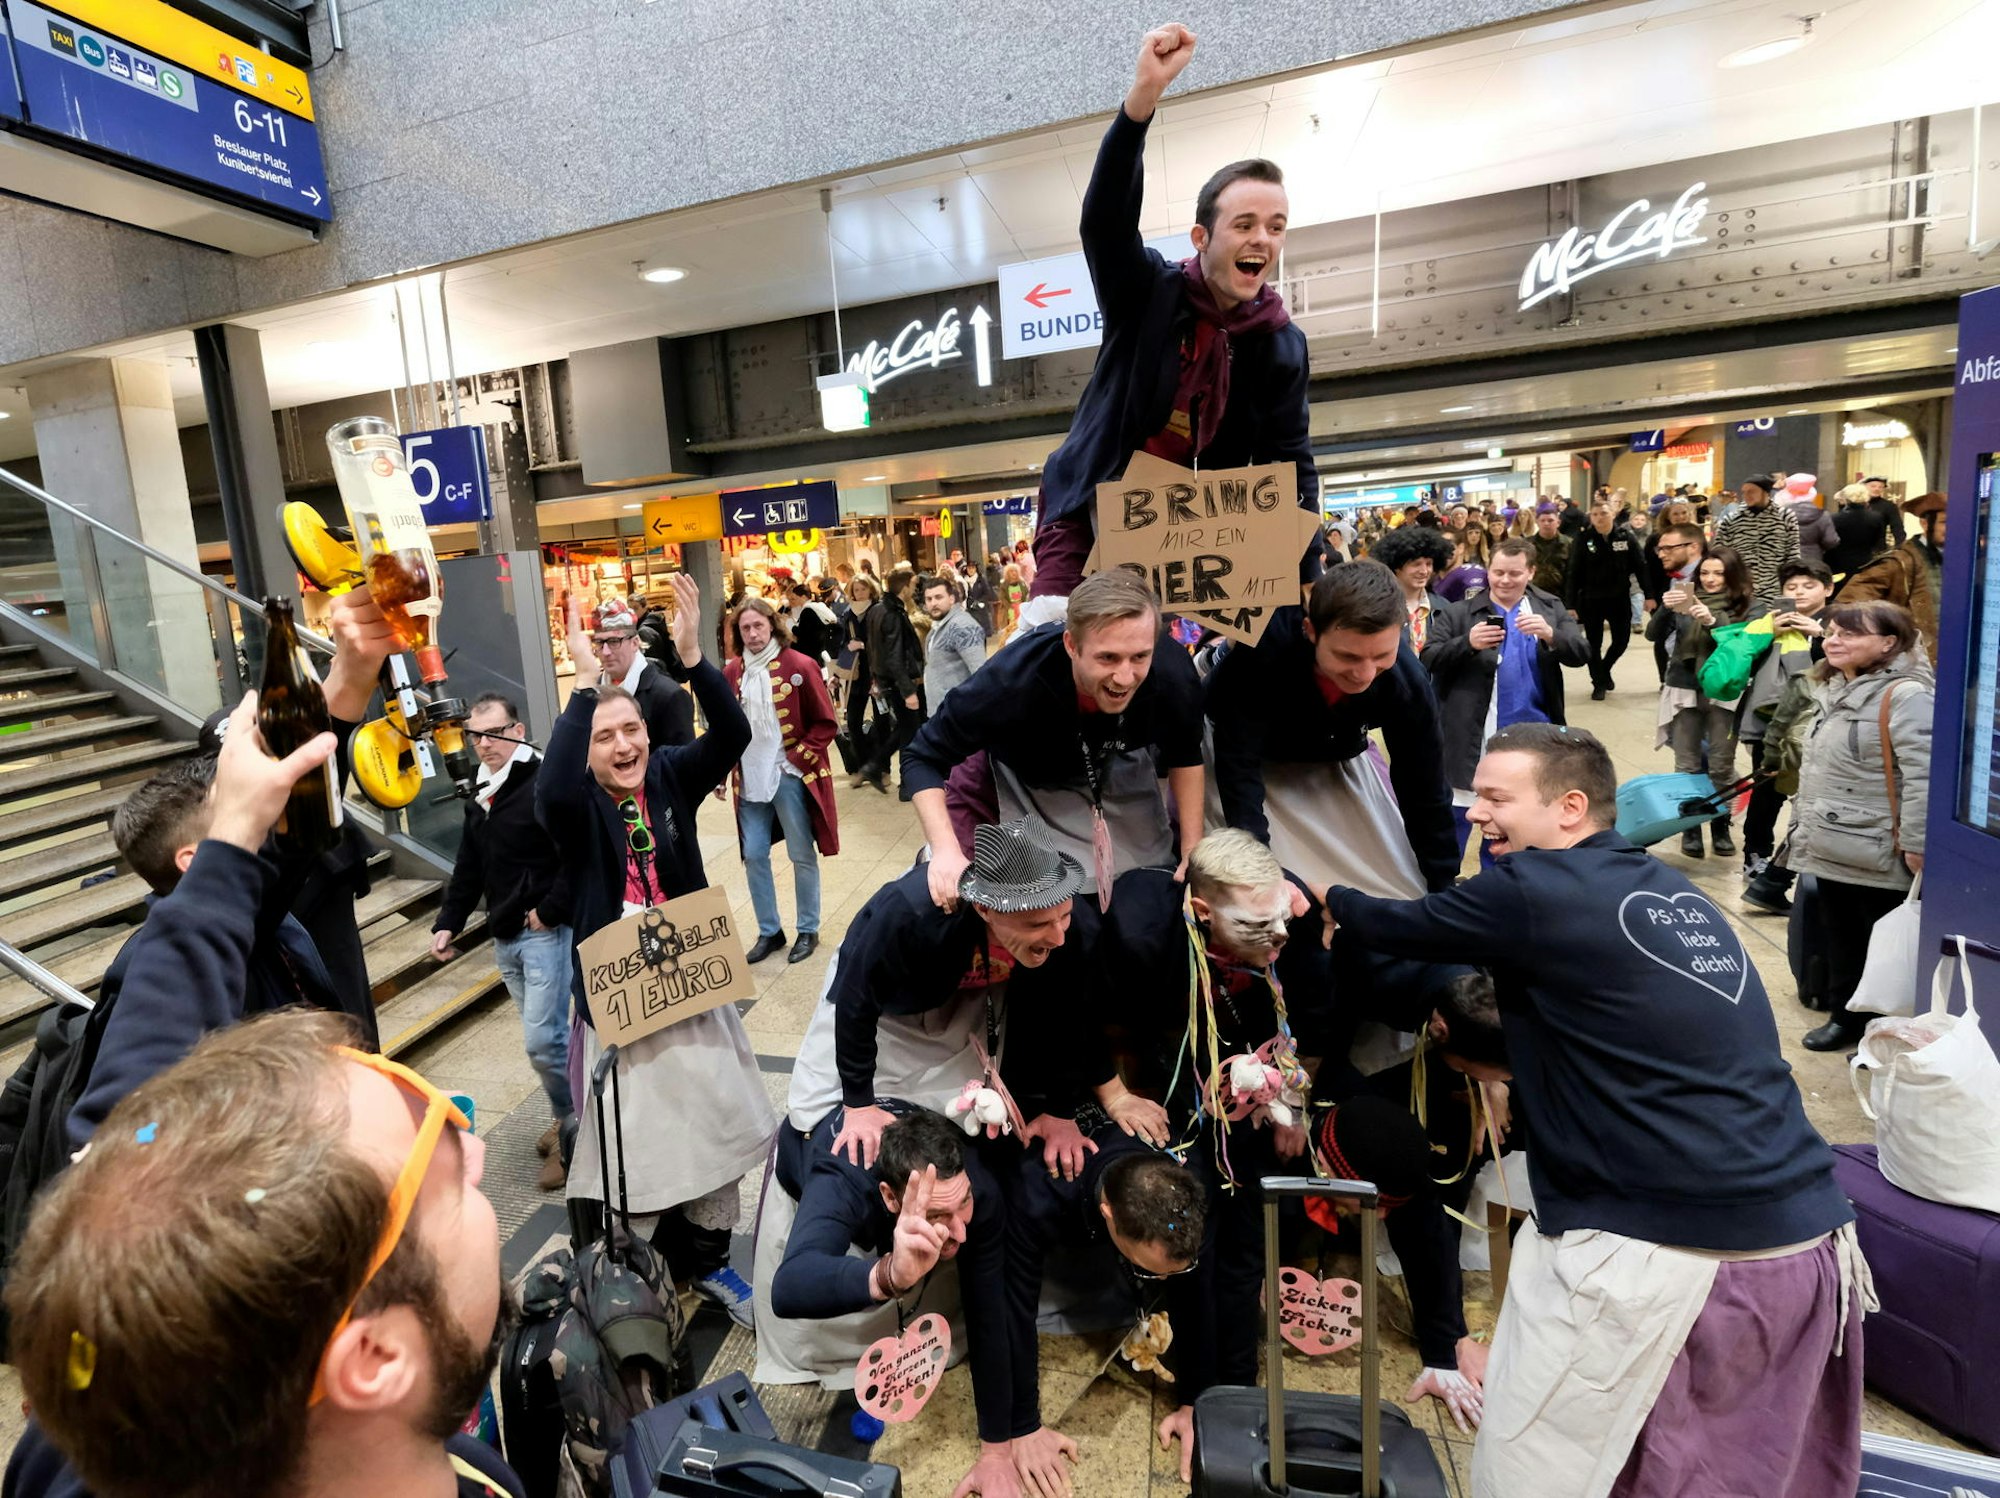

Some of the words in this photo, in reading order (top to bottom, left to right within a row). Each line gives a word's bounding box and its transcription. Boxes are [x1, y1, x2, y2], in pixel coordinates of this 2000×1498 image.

[51, 29, 73, 48] TAXI
[83, 43, 101, 59] Bus
[234, 99, 287, 147] 6-11
[213, 133, 262, 162] Breslauer
[263, 152, 291, 174] Platz,
[217, 151, 293, 189] Kunibertsviertel
[1519, 181, 1709, 300] McCafé
[405, 435, 441, 505] 5
[445, 483, 472, 501] C-F
[1116, 475, 1279, 531] BRING
[683, 522, 697, 531] WC
[1159, 529, 1205, 552] MIR
[1215, 527, 1247, 547] EIN
[1242, 576, 1286, 598] MIT
[1646, 907, 1678, 925] PS:
[1676, 907, 1710, 924] Ich
[1675, 930, 1720, 948] liebe
[1691, 954, 1741, 973] dicht!
[606, 990, 631, 1030] 1
[641, 955, 732, 1019] EURO
[1284, 1288, 1353, 1315] Zicken
[1280, 1309, 1352, 1337] Ficken
[869, 1361, 893, 1380] Von
[896, 1336, 938, 1368] ganzem
[879, 1364, 935, 1408] Ficken!
